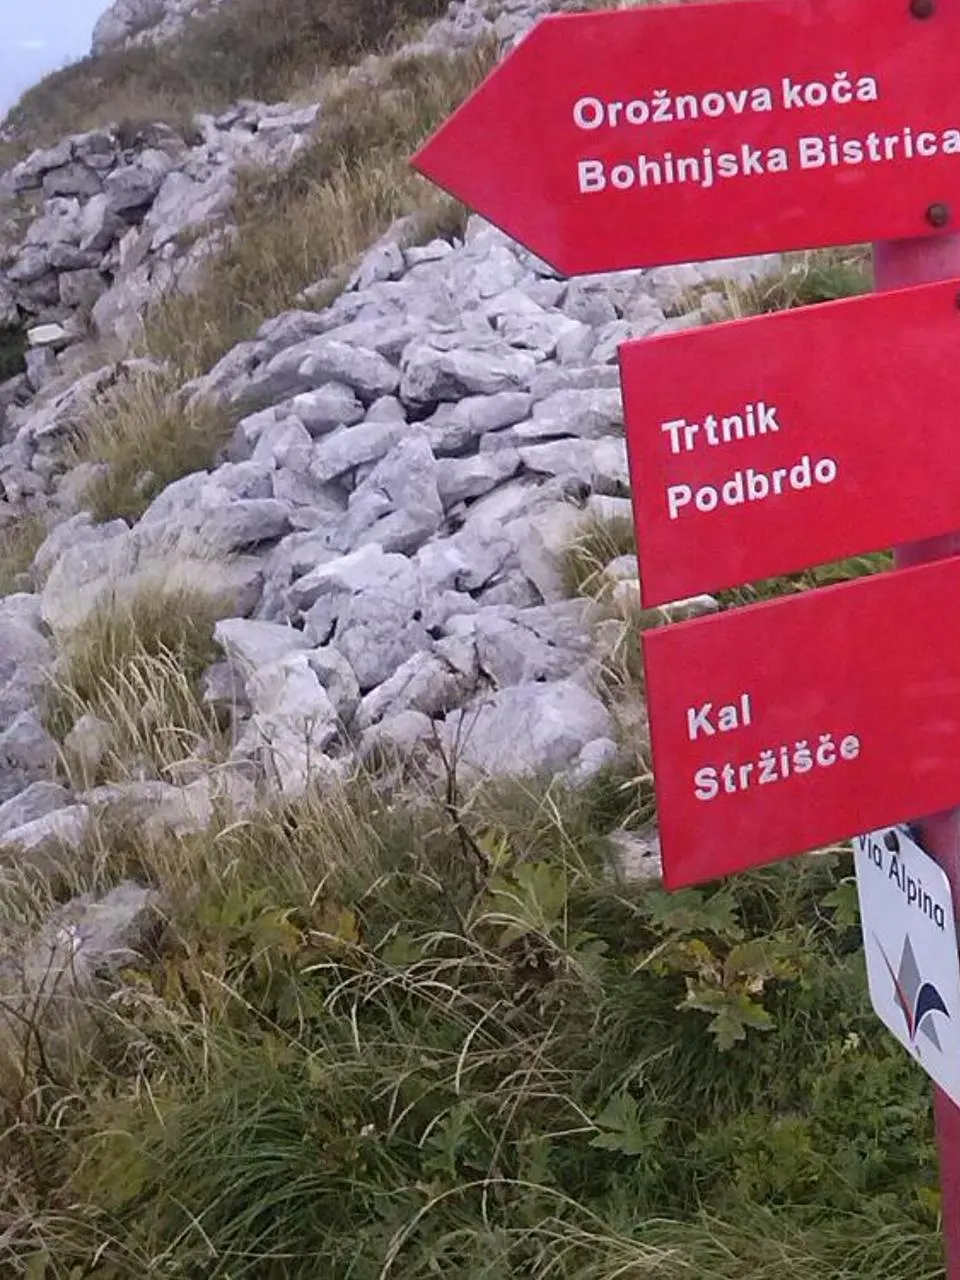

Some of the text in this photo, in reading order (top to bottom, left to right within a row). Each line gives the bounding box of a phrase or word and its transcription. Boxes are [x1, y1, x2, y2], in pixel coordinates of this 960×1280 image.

[572, 87, 773, 130] Orožnova
[782, 71, 878, 109] koča
[577, 144, 789, 194] Bohinjska
[661, 401, 780, 454] Trtnik
[667, 454, 837, 520] Podbrdo
[687, 693, 751, 740] Kal
[693, 731, 860, 801] Stržišče
[889, 854, 945, 931] Alpina
